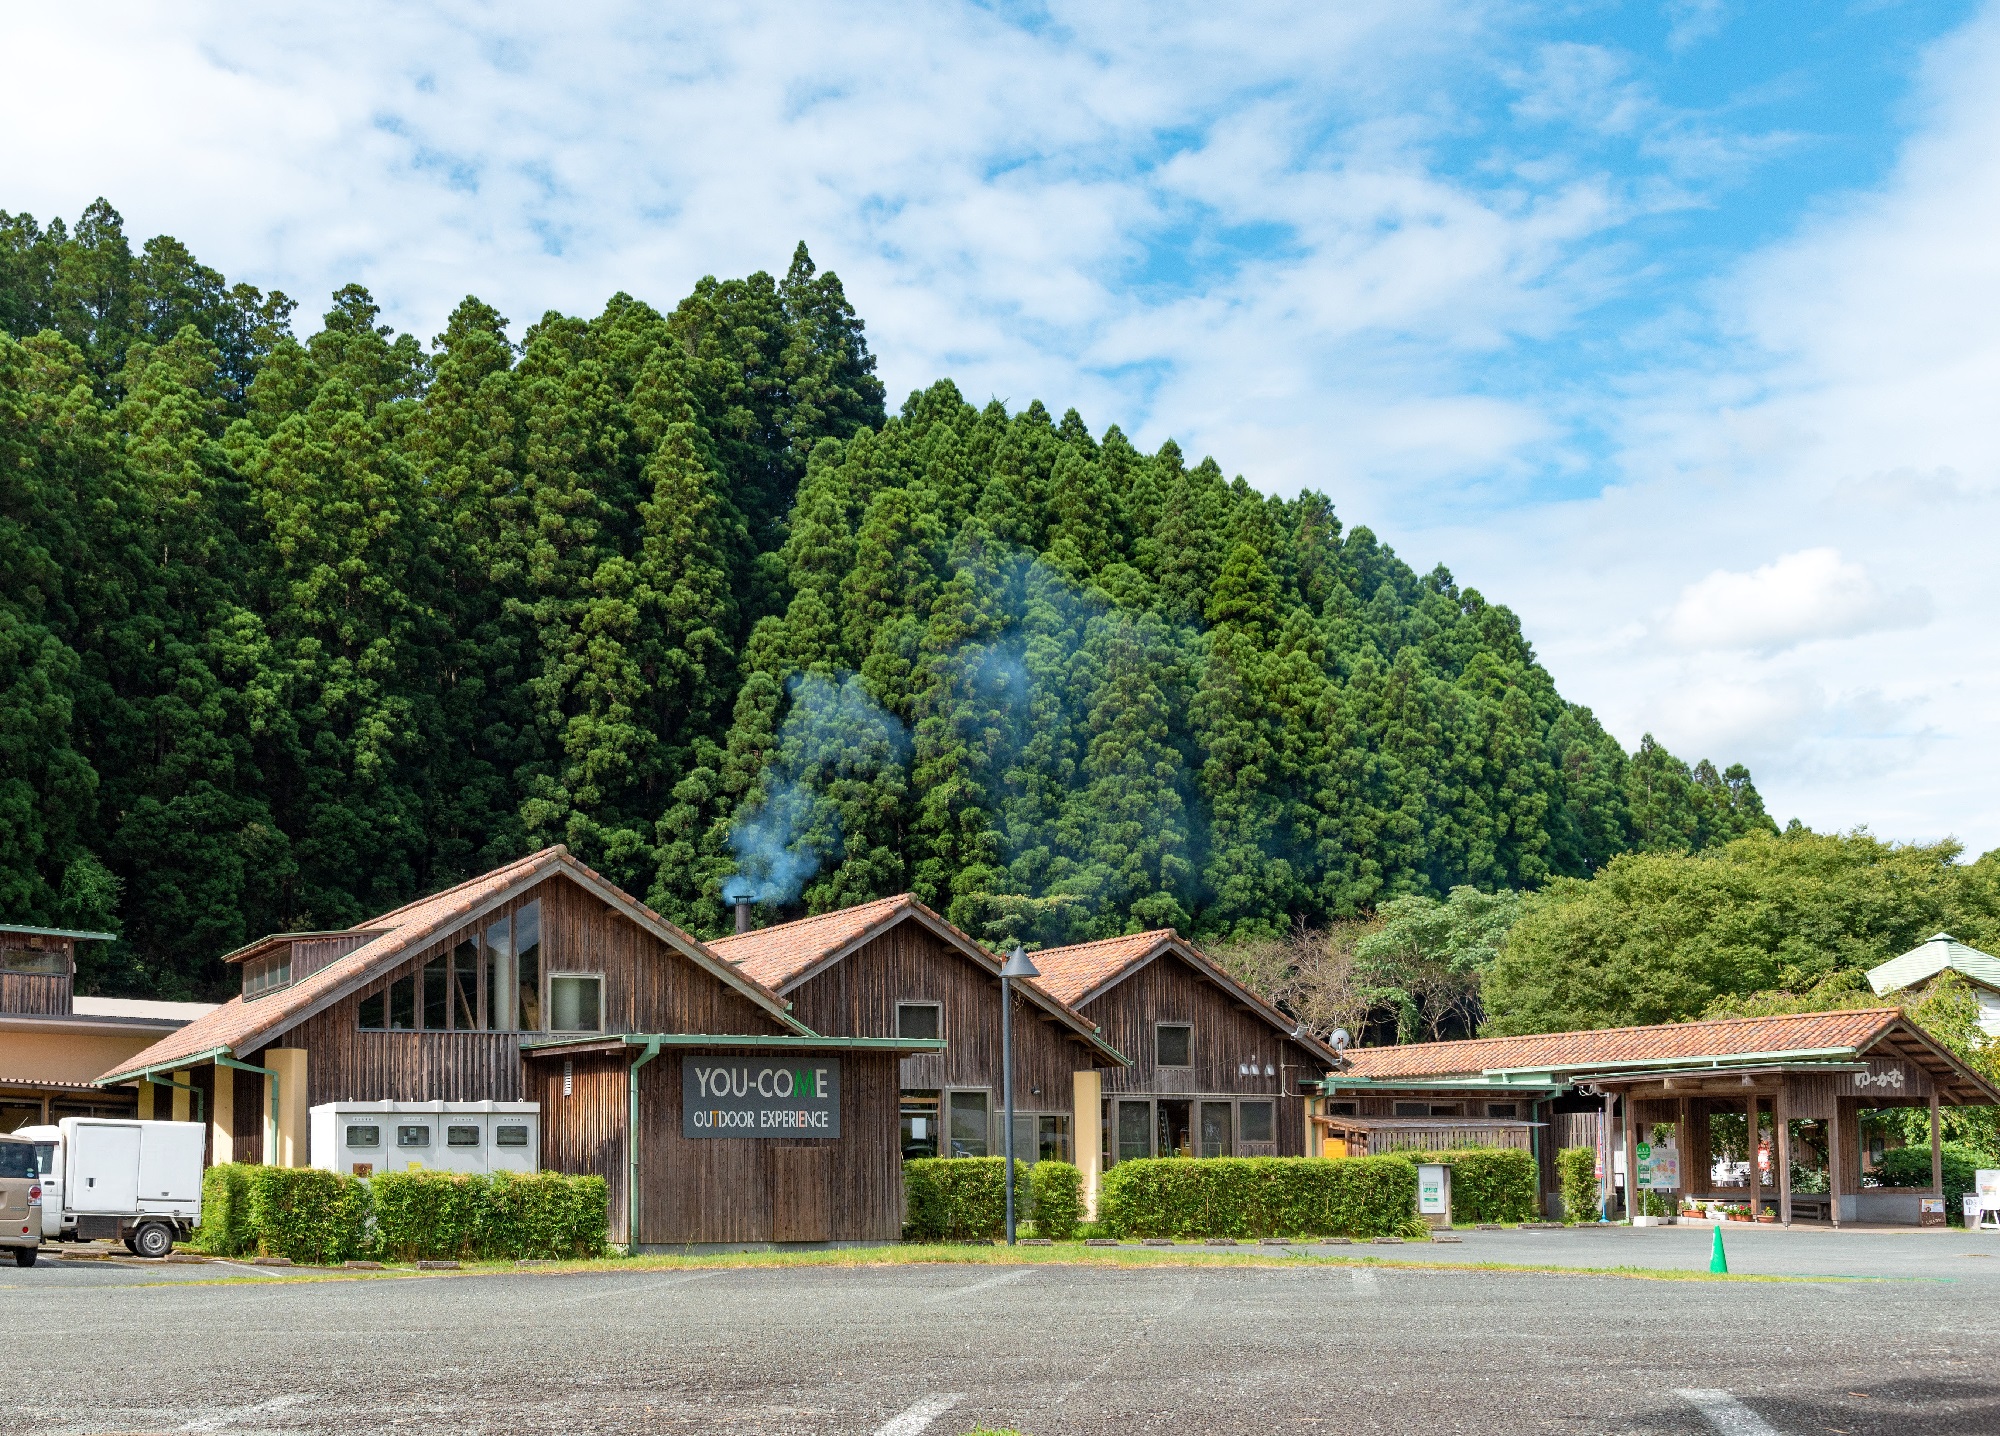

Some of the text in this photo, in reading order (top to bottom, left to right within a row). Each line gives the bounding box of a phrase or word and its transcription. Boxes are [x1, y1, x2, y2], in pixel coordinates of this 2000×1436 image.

[694, 1067, 828, 1098] YOU-COME
[693, 1110, 829, 1128] OUTDOOR EXPERIENCE
